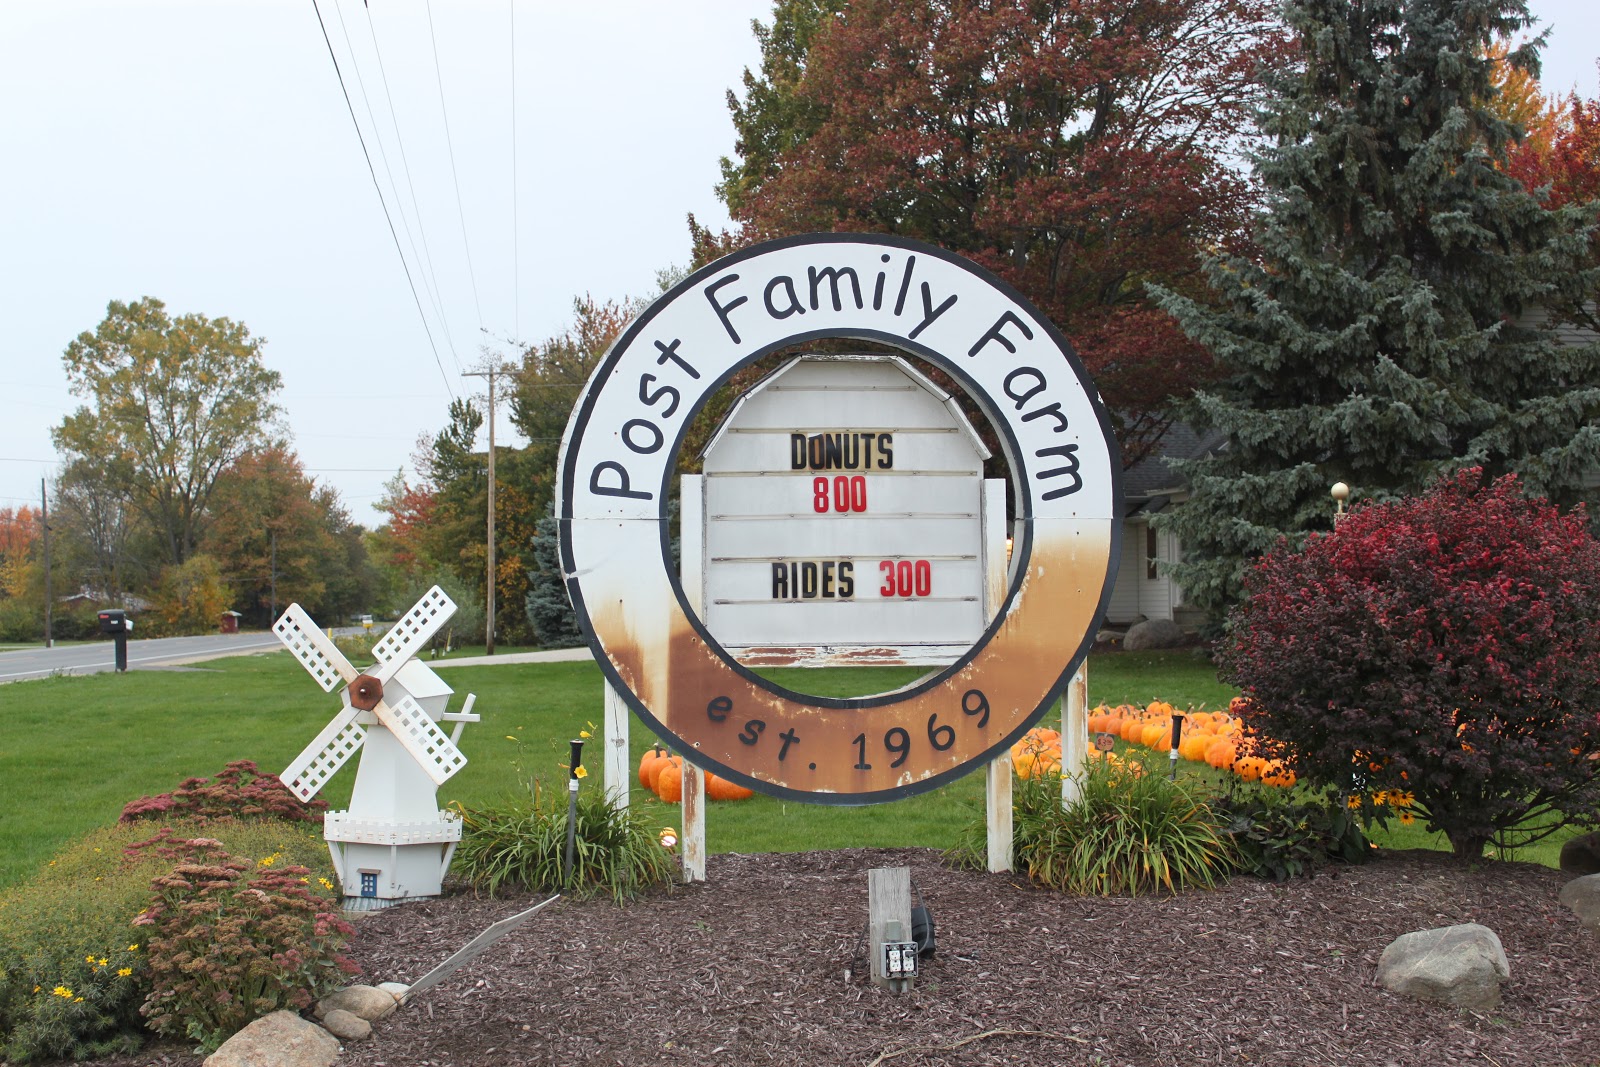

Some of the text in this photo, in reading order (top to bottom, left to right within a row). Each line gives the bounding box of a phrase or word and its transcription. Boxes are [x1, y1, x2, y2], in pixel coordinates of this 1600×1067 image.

[590, 254, 1083, 501] Post Family Farm
[791, 433, 893, 470] DONUTS
[813, 476, 867, 513] 800
[772, 560, 931, 599] RIDES 300
[706, 689, 990, 770] est. 1969
